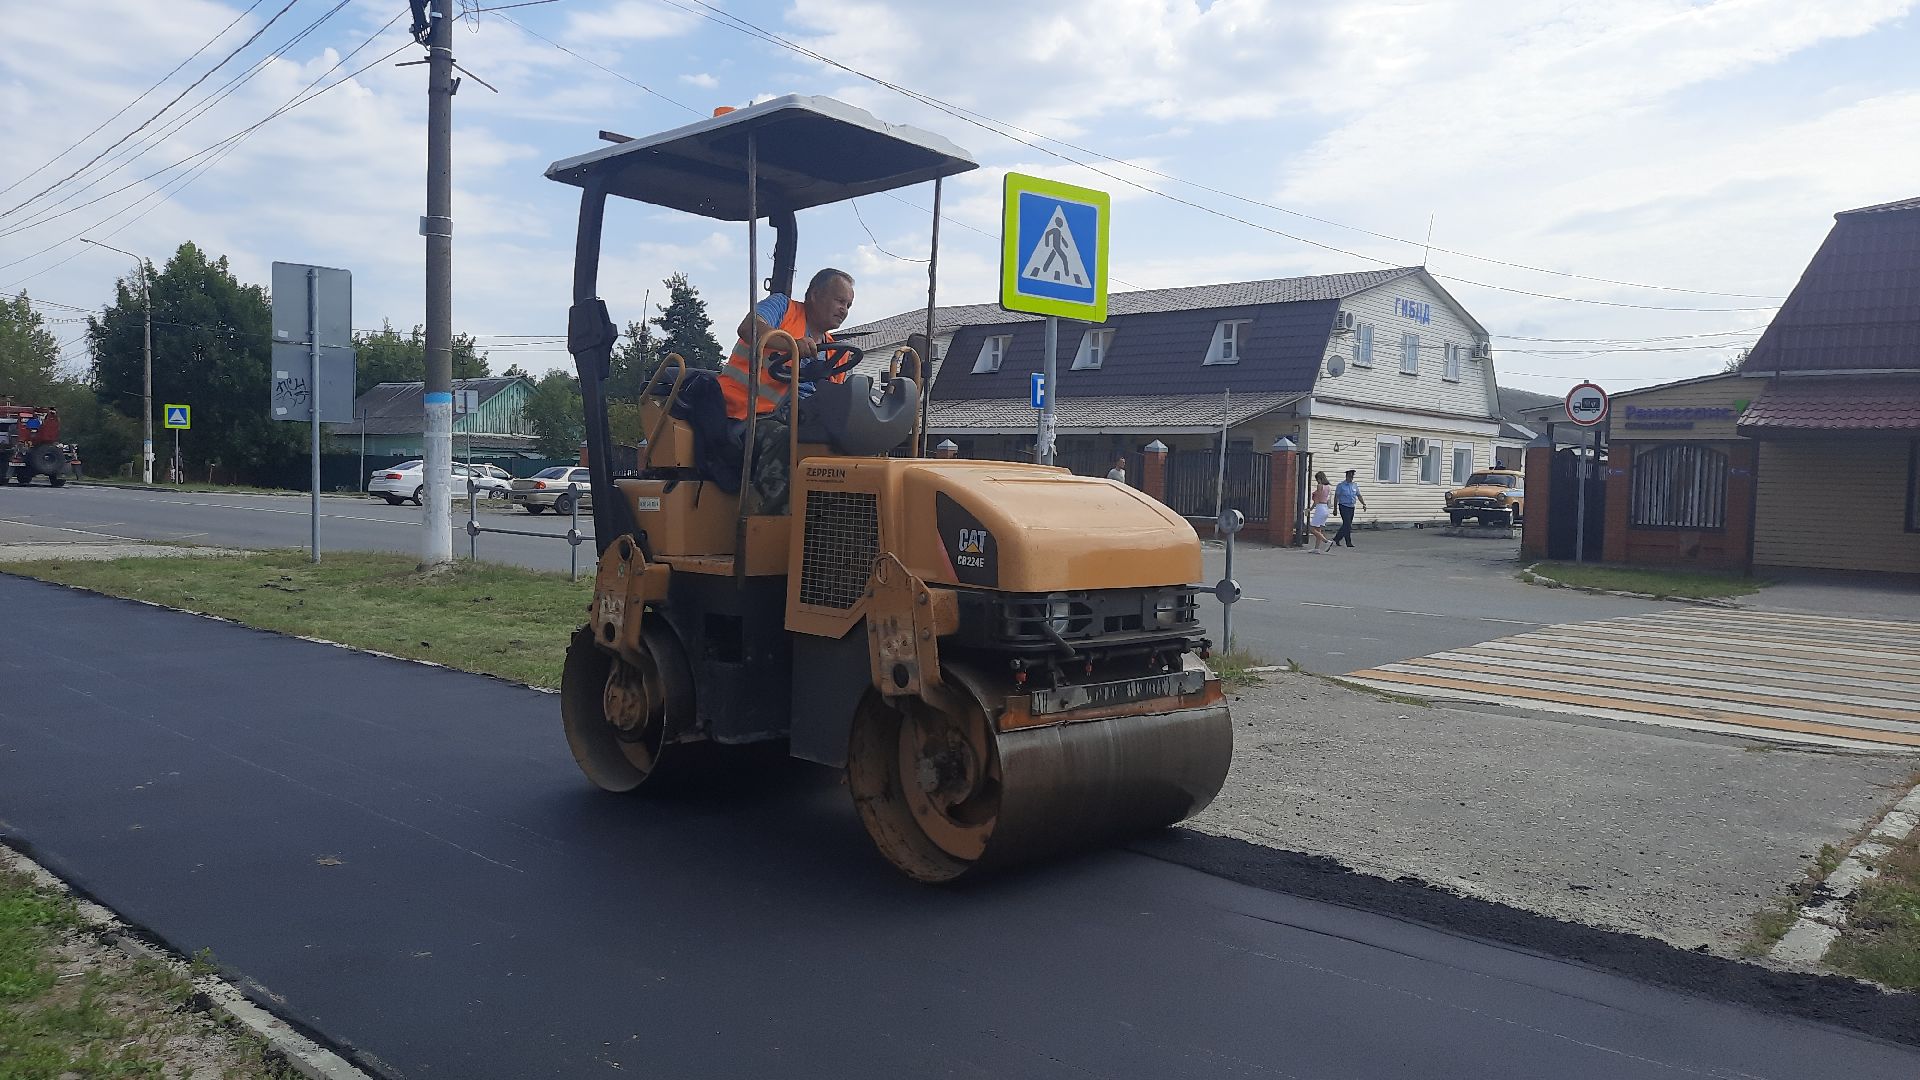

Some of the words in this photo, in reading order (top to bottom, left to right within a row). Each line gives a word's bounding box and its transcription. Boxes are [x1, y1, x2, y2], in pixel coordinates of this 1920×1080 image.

[1395, 296, 1430, 326] ГИБДД
[806, 467, 846, 478] ZEPPELIN
[958, 528, 987, 554] CAT
[957, 555, 985, 568] CB224E
